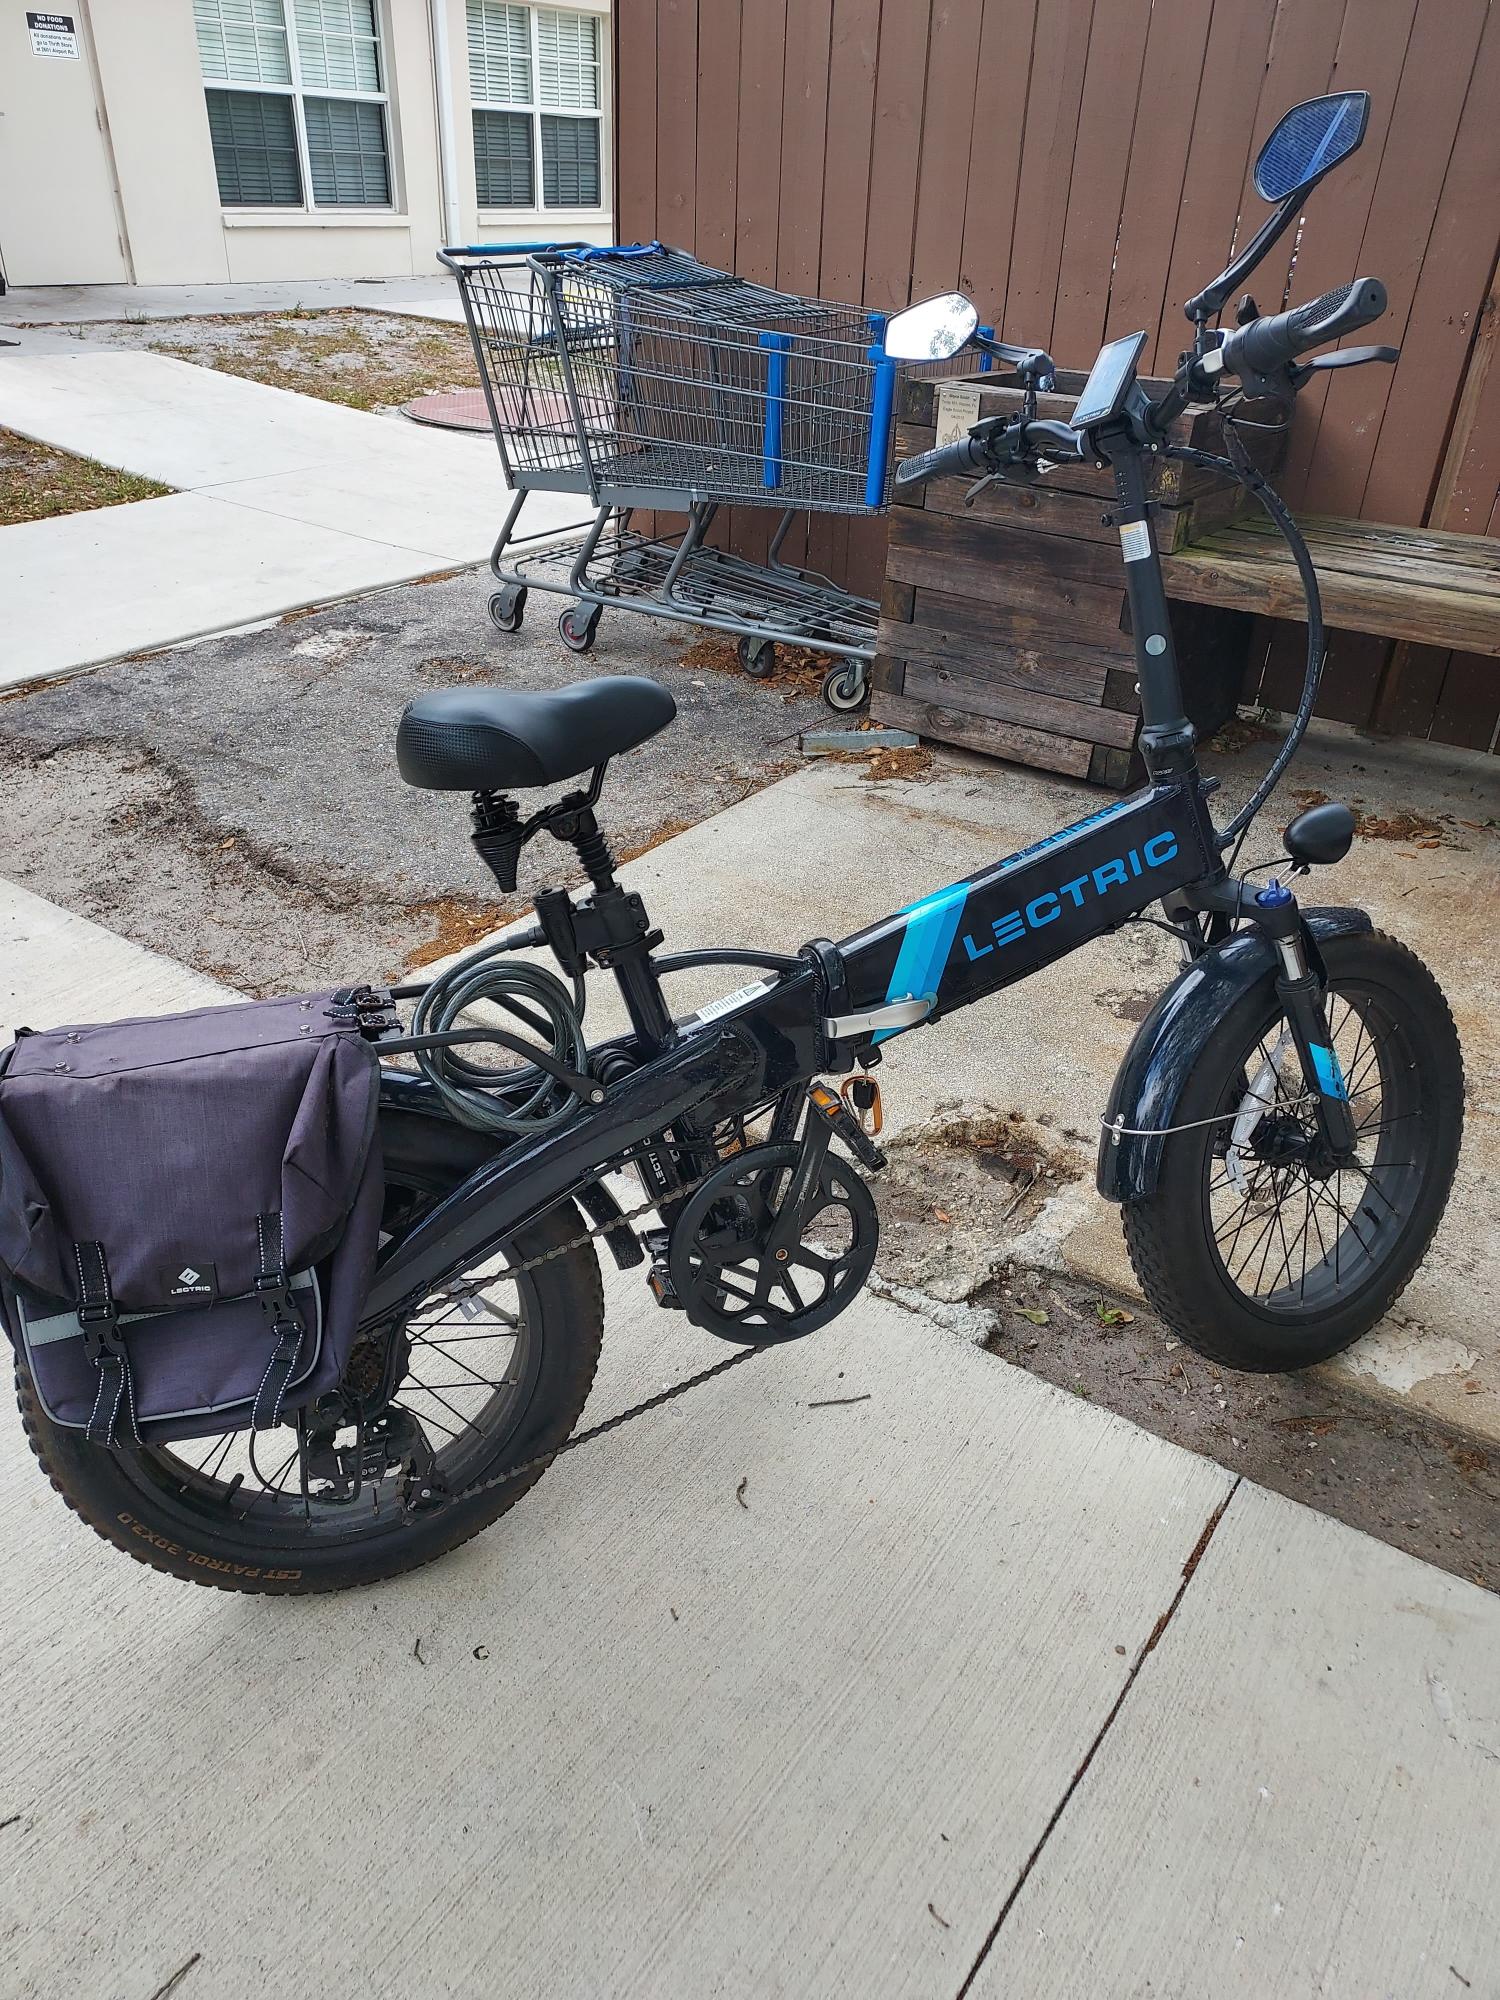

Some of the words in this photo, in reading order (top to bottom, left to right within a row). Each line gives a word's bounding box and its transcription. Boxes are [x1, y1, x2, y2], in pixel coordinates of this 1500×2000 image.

[34, 22, 68, 31] DONATIONS
[962, 831, 1179, 961] LECTRIC
[643, 1137, 667, 1185] LECTC
[170, 1285, 211, 1295] LECTRIC
[186, 1549, 262, 1577] PATROL
[262, 1569, 302, 1581] CST
